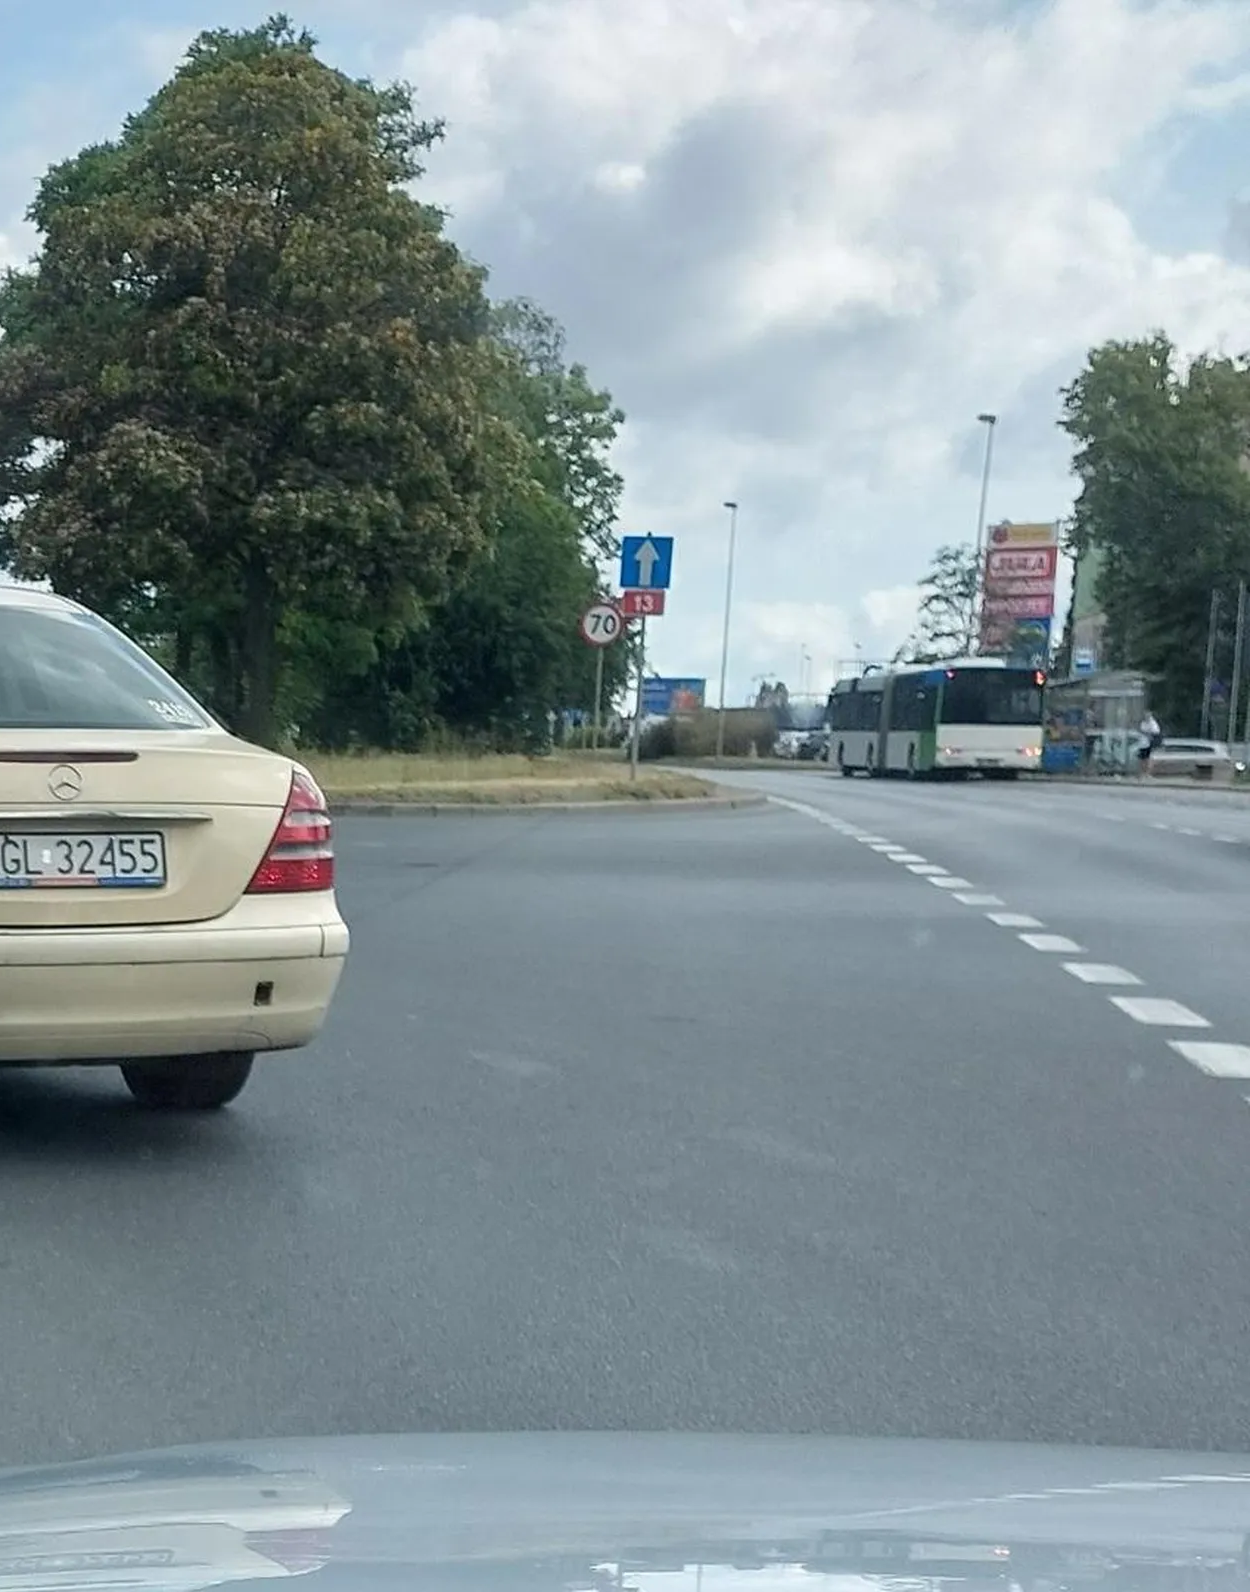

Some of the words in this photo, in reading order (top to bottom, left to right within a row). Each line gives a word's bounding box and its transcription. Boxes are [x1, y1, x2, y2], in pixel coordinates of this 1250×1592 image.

[633, 595, 653, 611] 13
[590, 613, 617, 635] 70
[56, 837, 159, 877] 32455
